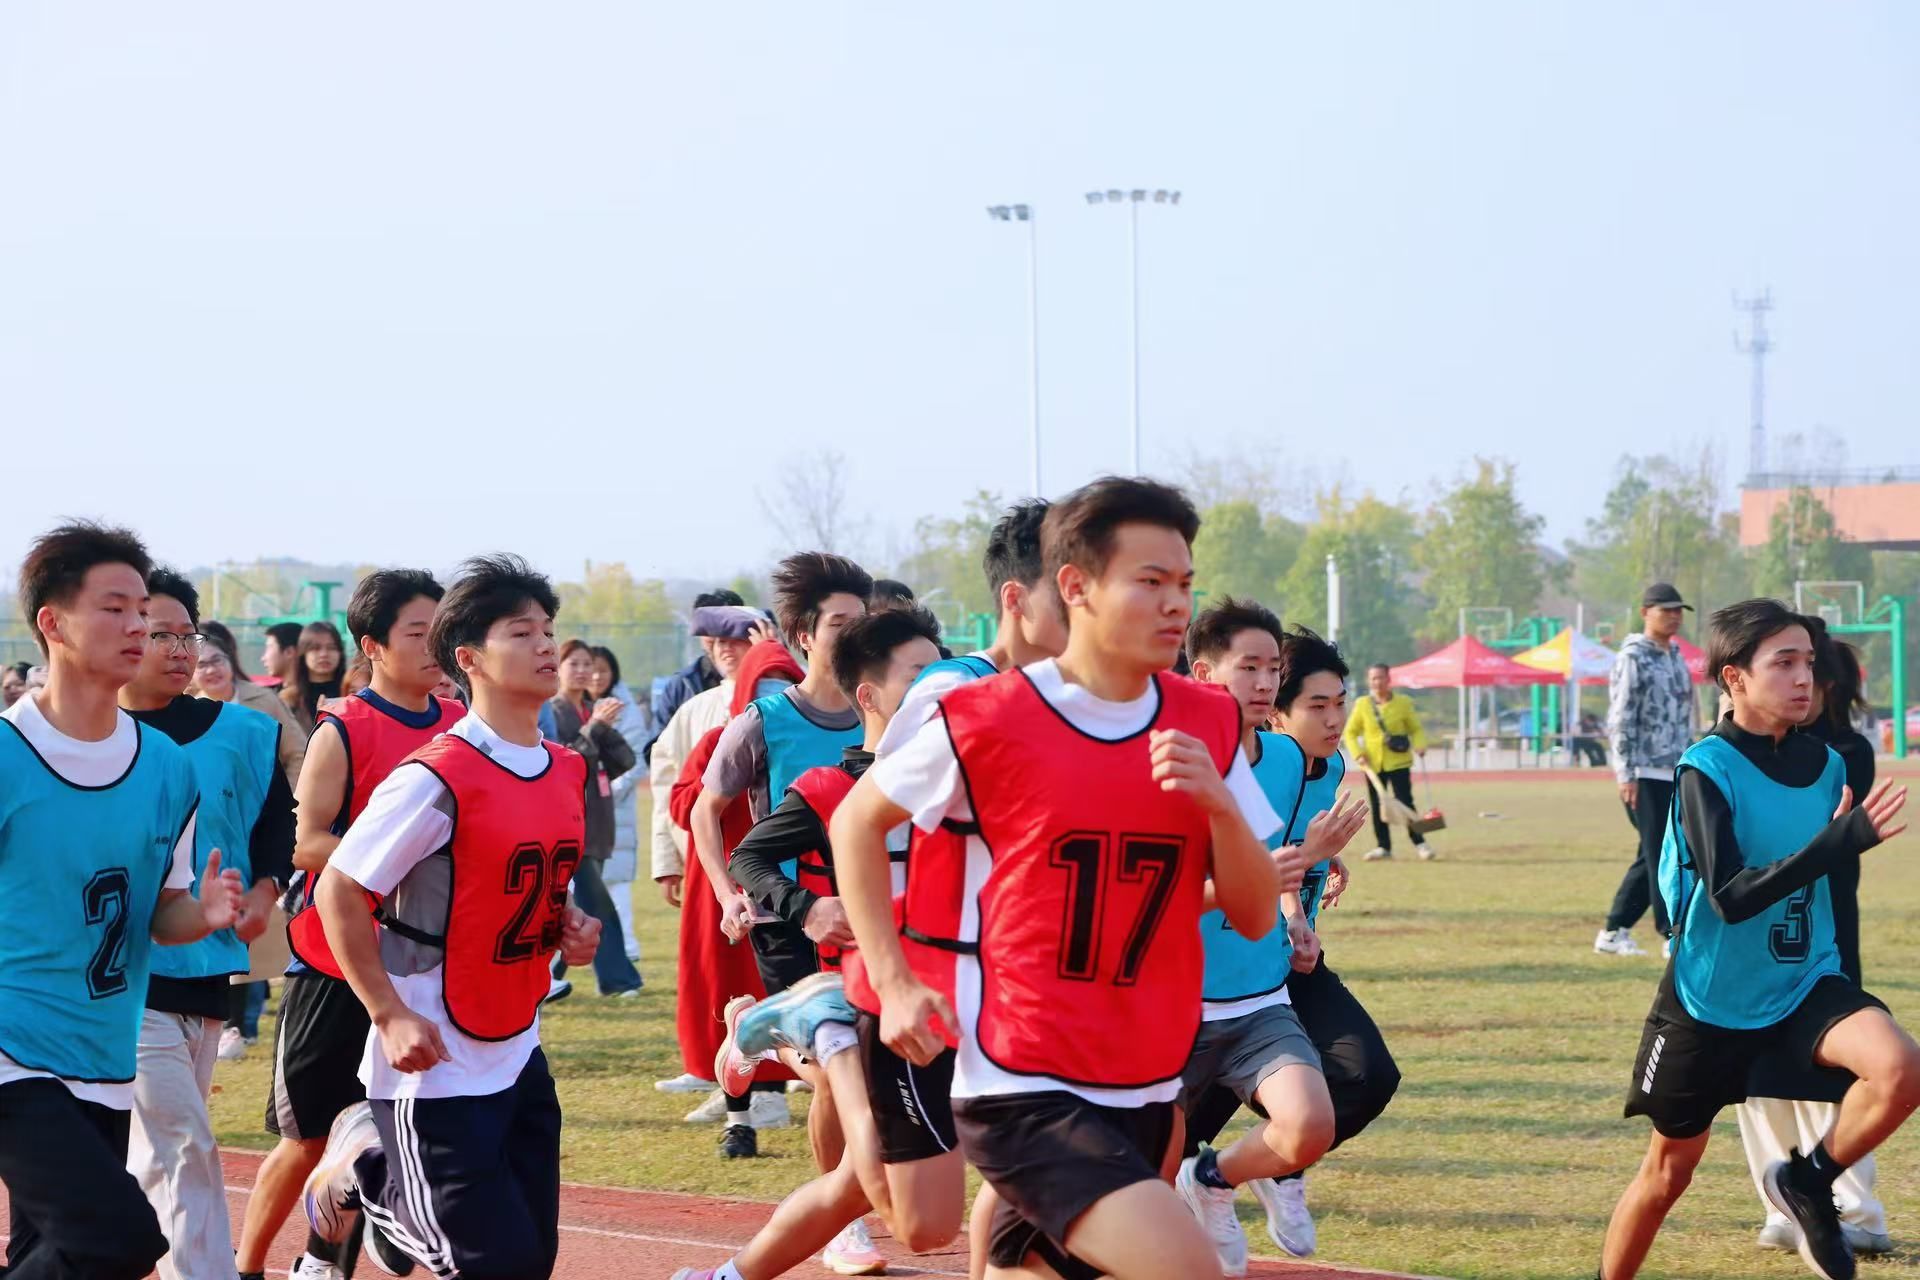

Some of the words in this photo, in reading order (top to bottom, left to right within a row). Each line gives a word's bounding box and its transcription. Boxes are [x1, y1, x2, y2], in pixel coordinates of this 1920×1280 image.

[82, 867, 131, 1000] 2
[1049, 829, 1187, 987] 17
[1768, 880, 1814, 964] 3
